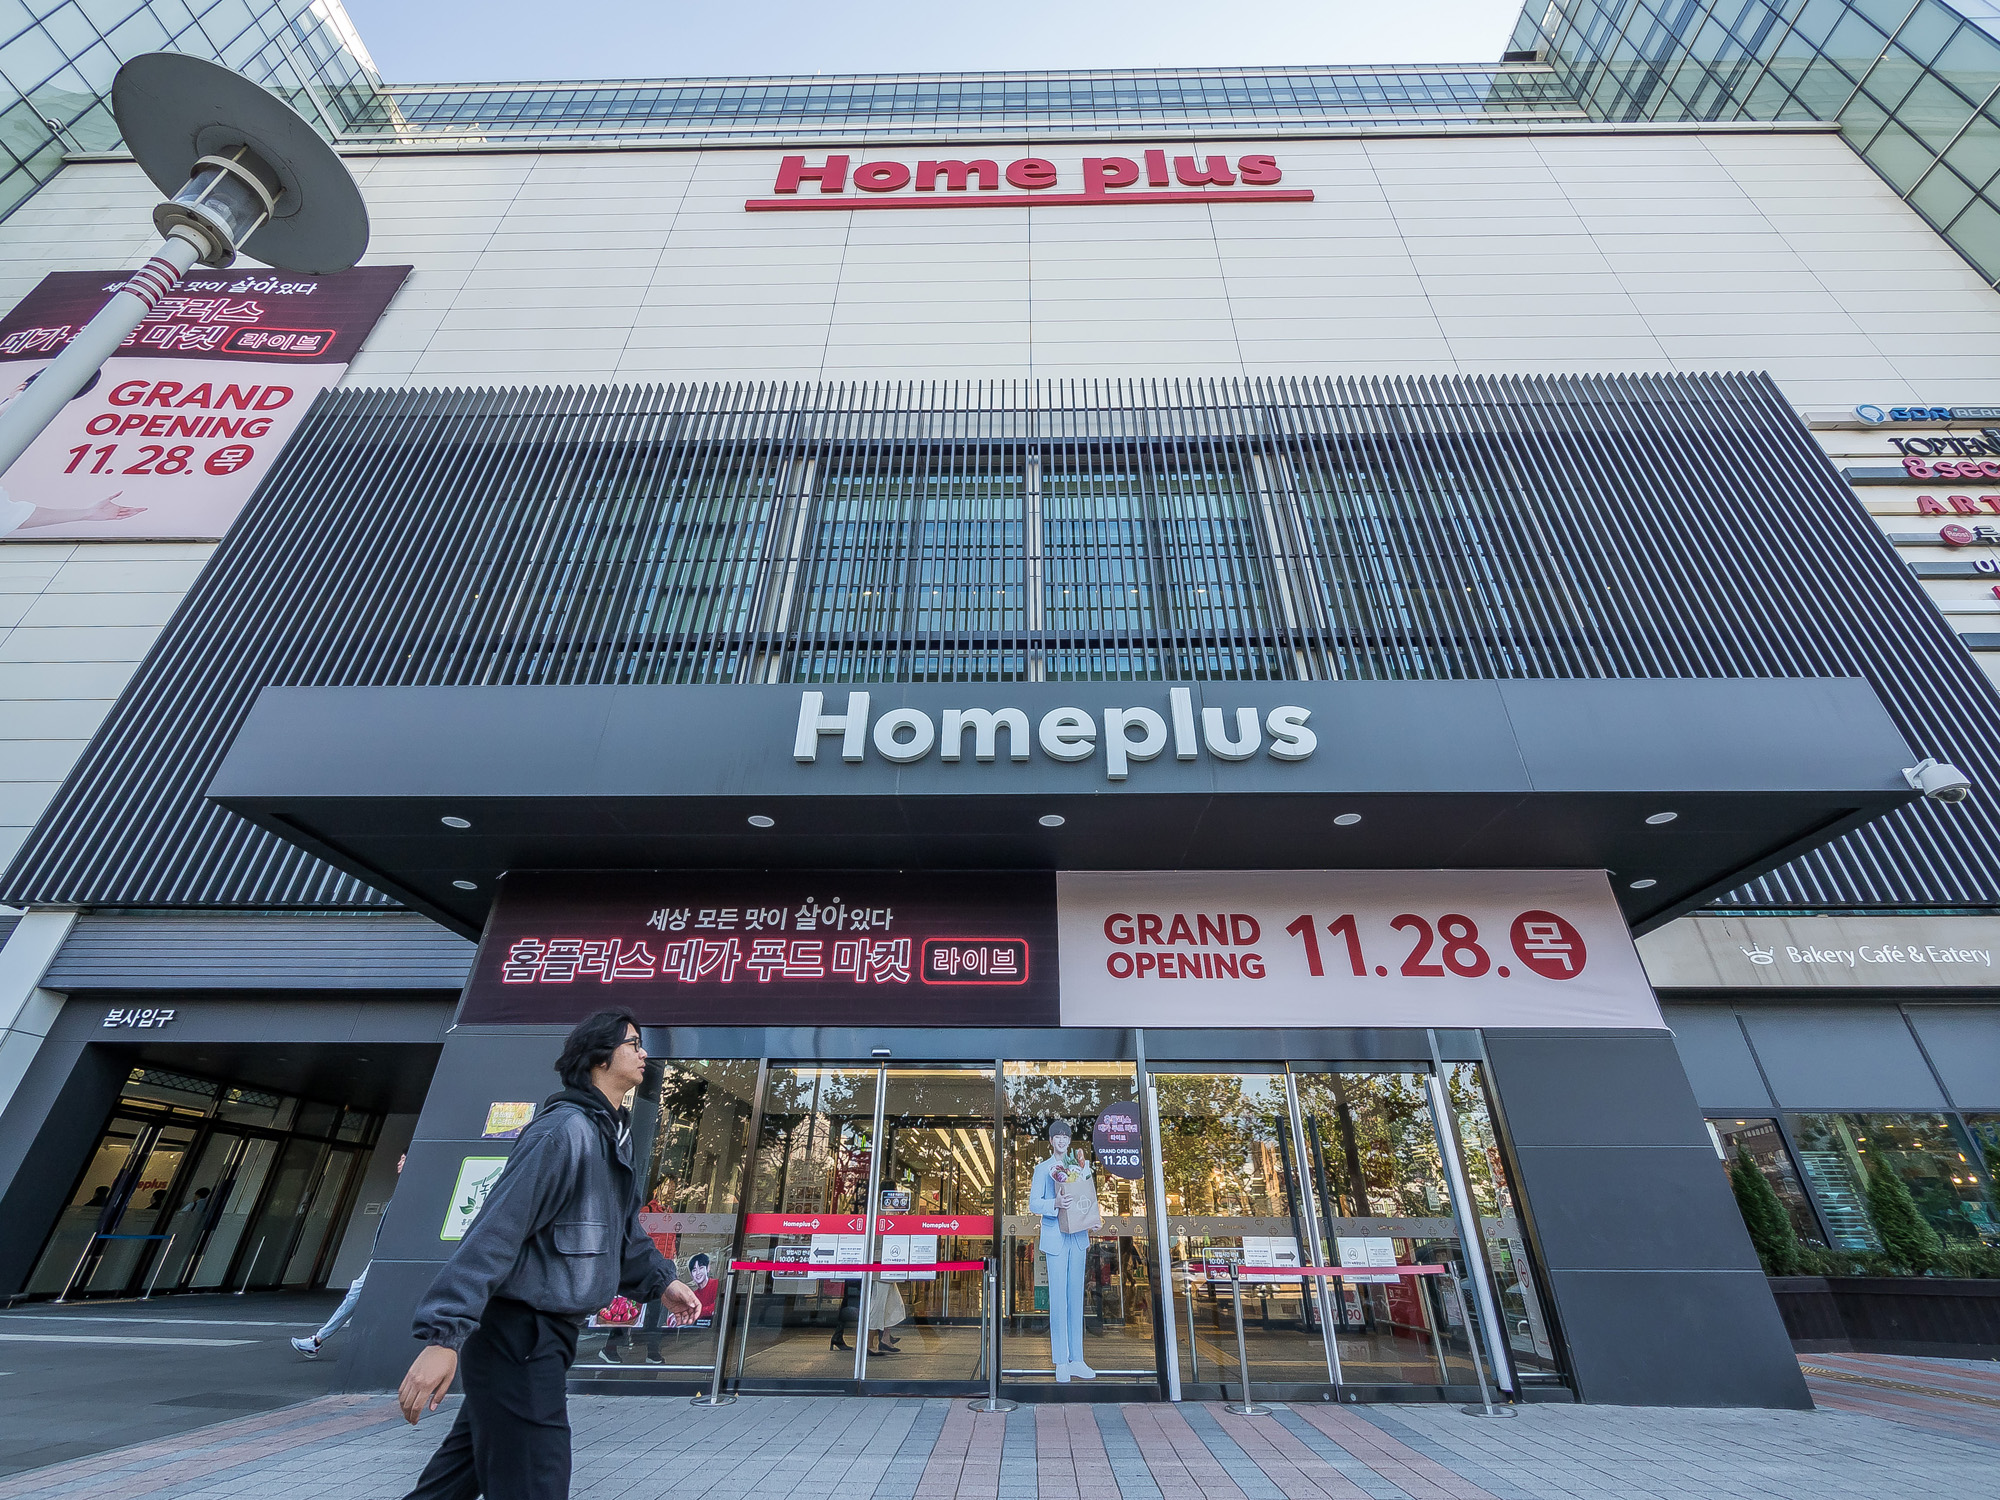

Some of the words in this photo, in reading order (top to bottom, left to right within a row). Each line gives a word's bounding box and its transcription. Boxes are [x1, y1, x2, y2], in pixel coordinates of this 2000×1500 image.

[101, 281, 127, 293] 세
[188, 281, 227, 293] 맛이
[228, 276, 318, 296] 살아있다
[142, 297, 265, 323] 플러스
[0, 326, 69, 354] 메가
[142, 324, 230, 352] 마켓
[237, 332, 324, 352] 라이브
[108, 380, 295, 411] GRAND
[86, 413, 275, 439] OPENING
[209, 447, 251, 473] 목
[793, 687, 1318, 780] Homeplus
[646, 908, 691, 931] 세상
[694, 908, 739, 931] 모든
[745, 907, 788, 931] 맛이
[794, 897, 894, 931] 살아있다
[1103, 913, 1262, 947] GRAND
[1517, 917, 1580, 976] 목
[1785, 945, 1855, 967] Bakery
[1858, 944, 1906, 963] Café
[1907, 945, 1927, 963] &
[1926, 945, 1992, 967] Eatery
[503, 939, 656, 983] 홈플러스
[662, 939, 742, 983] 메가
[746, 939, 824, 983] 푸드
[832, 939, 912, 983] 마켓
[933, 947, 1018, 976] 라이브
[1106, 951, 1267, 980] OPENING
[102, 1008, 176, 1028] 본사입구
[783, 1220, 811, 1228] Homeplus
[922, 1221, 950, 1229] Homeplus
